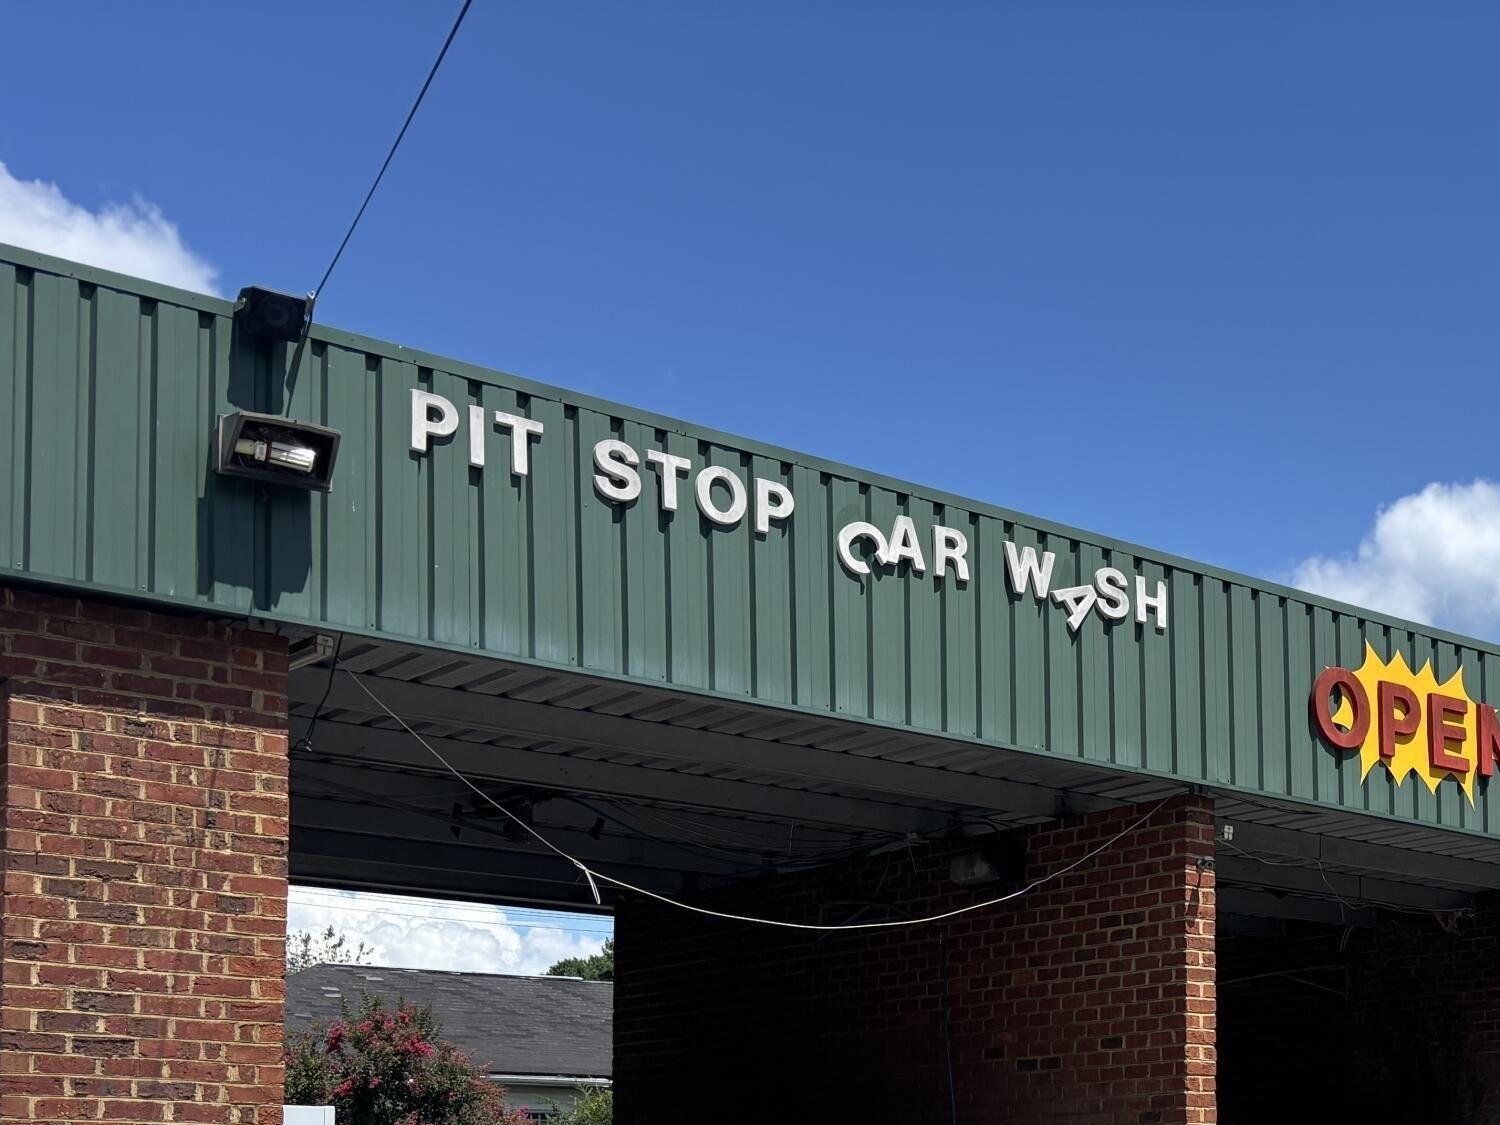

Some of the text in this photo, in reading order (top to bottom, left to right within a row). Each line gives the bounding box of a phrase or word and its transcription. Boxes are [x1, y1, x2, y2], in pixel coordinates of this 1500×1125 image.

[410, 388, 1167, 632] PIT STOP CAR WASH
